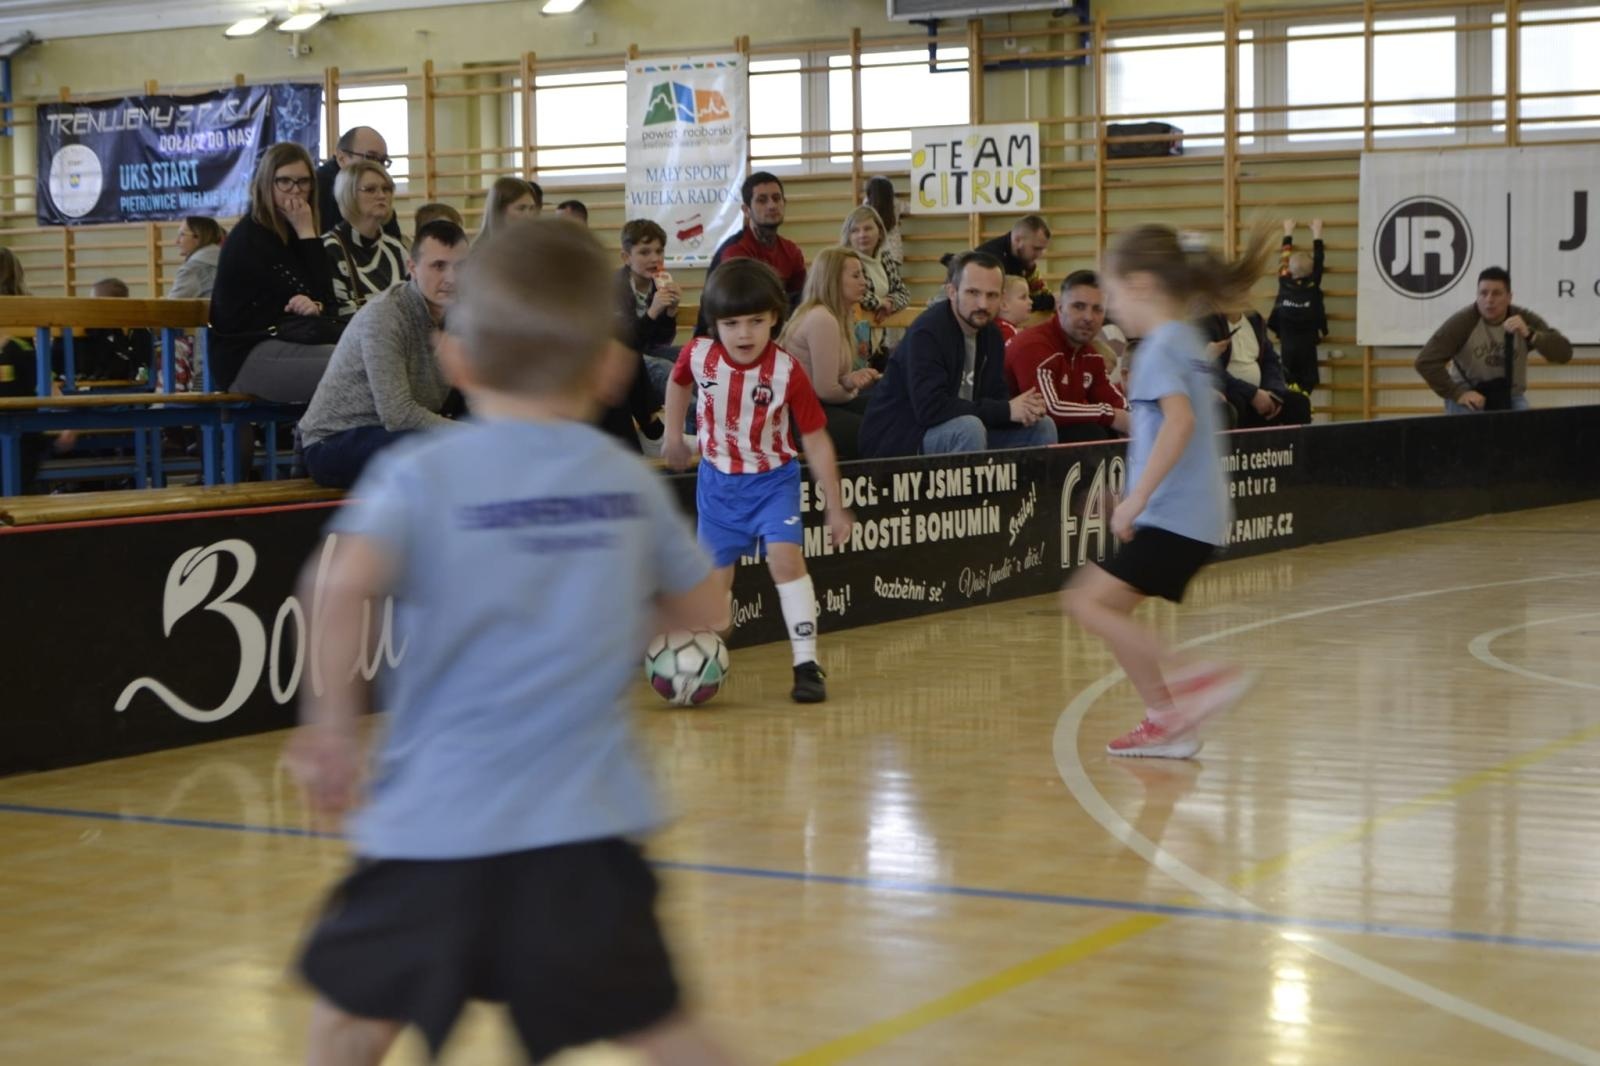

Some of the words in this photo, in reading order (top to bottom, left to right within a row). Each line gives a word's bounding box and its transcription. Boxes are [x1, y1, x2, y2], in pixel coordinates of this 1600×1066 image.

[207, 130, 225, 150] DO
[924, 134, 1032, 171] TEAM
[119, 164, 149, 191] UKS
[151, 160, 199, 189] START
[685, 162, 730, 182] SPORT
[119, 193, 177, 213] PIETROWICE
[630, 189, 684, 206] WIELKA
[918, 168, 1037, 209] CITRUS
[1391, 215, 1456, 277] JR
[1250, 443, 1293, 470] cestovní
[893, 471, 923, 503] MY
[925, 468, 973, 500] JSME
[974, 457, 1018, 494] TÝM!
[915, 498, 1001, 544] BOHUMÍN
[874, 575, 927, 601] Rozběhni
